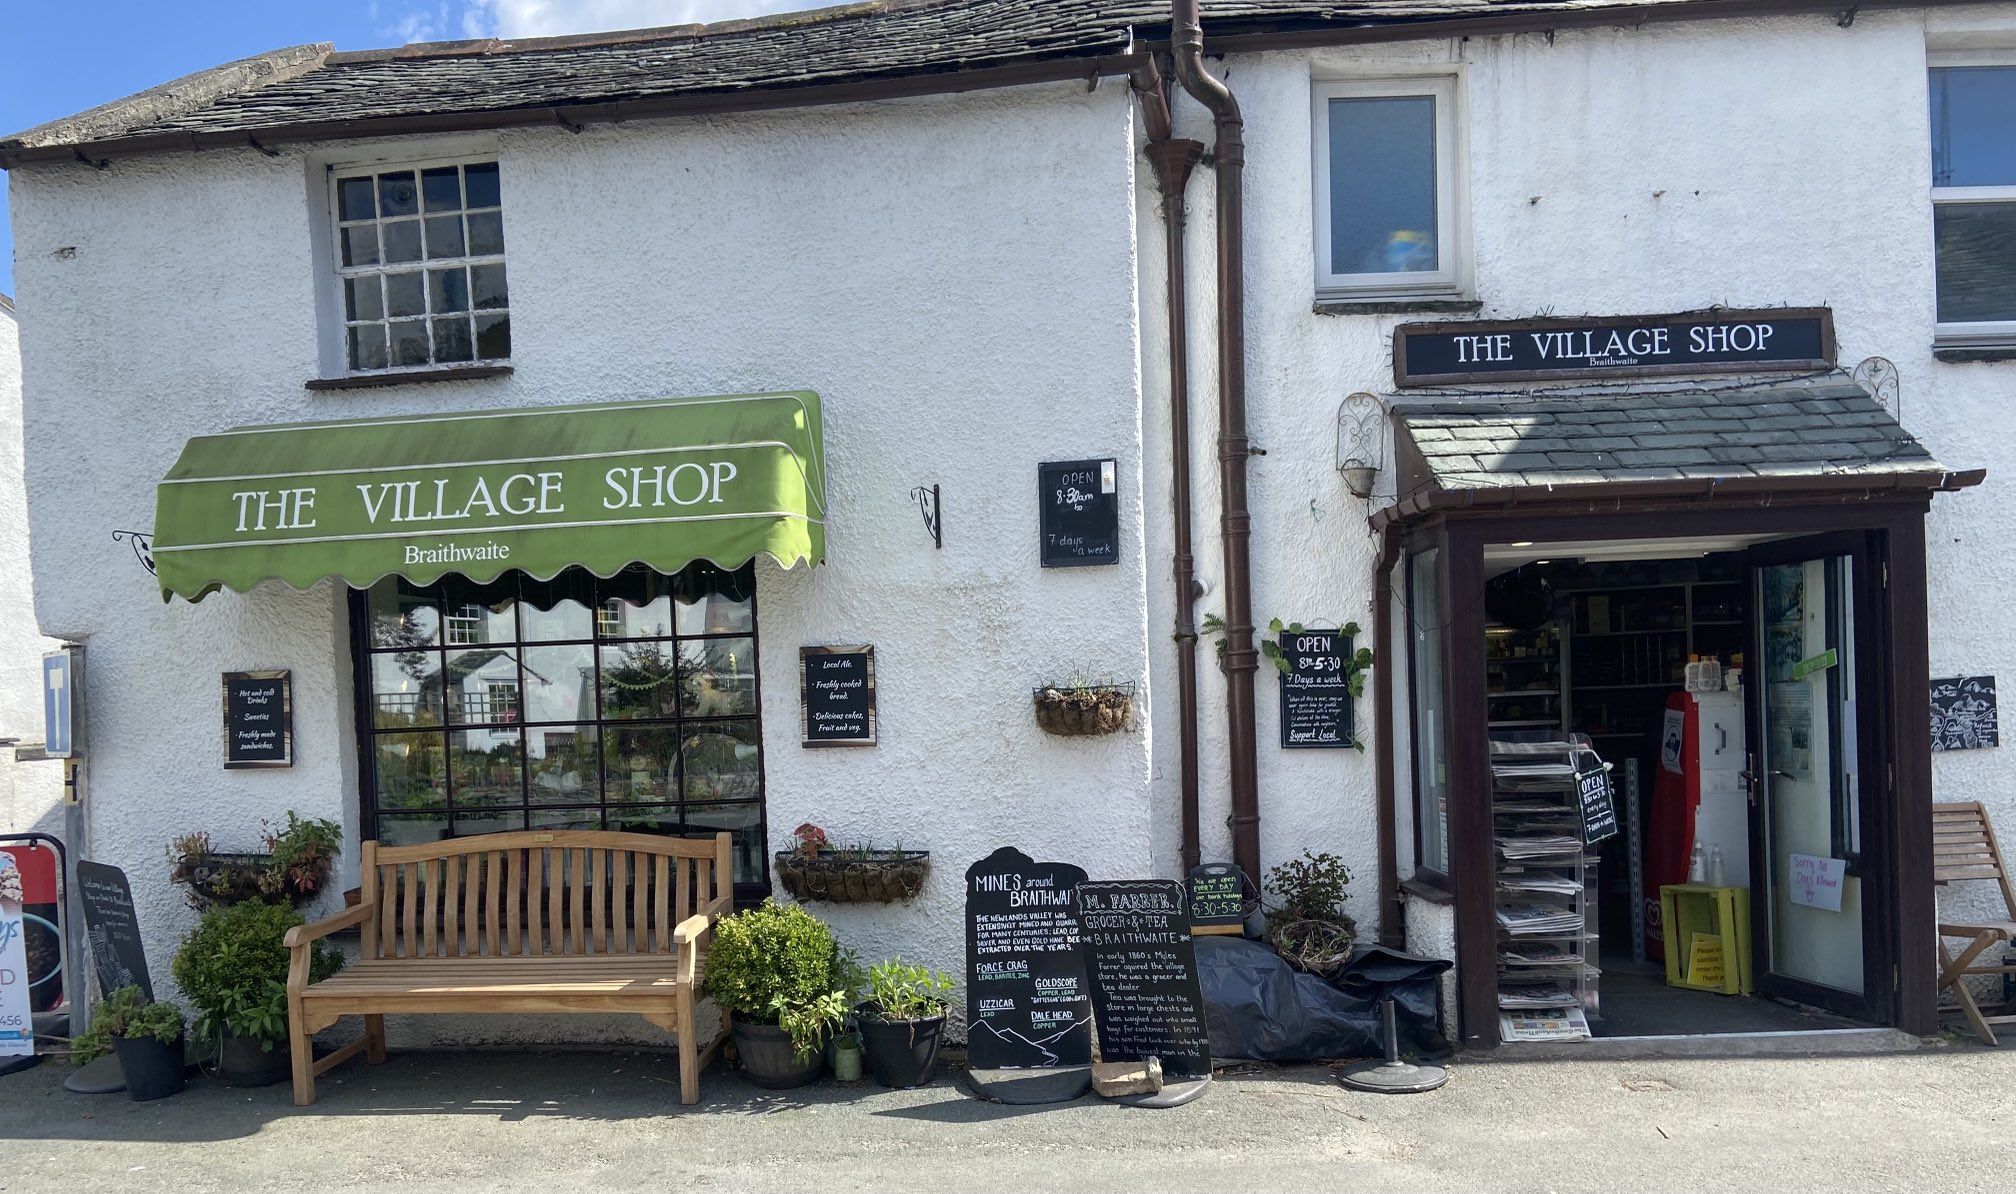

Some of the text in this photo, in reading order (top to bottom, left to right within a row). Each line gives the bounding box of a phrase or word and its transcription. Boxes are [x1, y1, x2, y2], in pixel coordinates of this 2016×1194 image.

[1454, 324, 1773, 363] THE VILLAGE SHOP
[1589, 356, 1638, 367] Braithwaite
[1062, 470, 1094, 485] OPEN
[232, 461, 737, 533] THE VILLAGE SHOP
[1048, 534, 1083, 553] 7 days
[1077, 543, 1111, 556] a week
[404, 540, 510, 565] Braithwaite
[1296, 636, 1331, 652] OPEN
[822, 659, 852, 669] Local Ale.
[816, 679, 862, 691] Freshly cooked
[1287, 673, 1293, 683] 7
[1294, 673, 1314, 690] Days
[1324, 672, 1342, 683] week
[250, 689, 262, 697] and
[263, 688, 275, 696] cold
[829, 691, 848, 700] bread.
[247, 696, 268, 705] Drinks
[244, 712, 270, 721] Sweeties
[815, 711, 864, 720] Delicious cakes,
[818, 723, 861, 733] Fruit and veg.
[238, 729, 276, 740] Freshly made
[1289, 728, 1336, 743] Support Local
[240, 741, 274, 750] sandwiches.
[1581, 774, 1604, 793] OPEN
[1793, 856, 1828, 875] Sorry No
[975, 873, 1054, 892] MINES around
[1220, 876, 1236, 884] open
[1193, 882, 1234, 892] EVERY DAY
[1010, 889, 1074, 907] BRAITHWAI
[1085, 893, 1175, 909] M. FARRER.
[976, 911, 1067, 923] THE NEWLANDS VALLEY WAS
[1085, 915, 1168, 931] GROCER & TEA
[976, 922, 1016, 931] EXTENSIVELY
[1055, 918, 1077, 926] QUARR
[977, 930, 990, 939] FOR
[1069, 927, 1080, 935] COP
[1094, 932, 1178, 945] BRAITHWAITE
[976, 938, 996, 947] SILVER
[1012, 937, 1030, 945] EVEN
[1031, 936, 1048, 944] GOLD
[1066, 935, 1080, 943] BEE
[977, 945, 1012, 954] EXTRACTED
[1013, 944, 1030, 952] OVER
[1047, 943, 1074, 952] YEARS.
[1107, 951, 1125, 963] early
[1154, 951, 1177, 964] Myles
[976, 959, 1028, 974] FORCE CRAG
[1098, 961, 1120, 970] Farrer
[1151, 961, 1164, 970] the
[1165, 961, 1185, 973] village
[1035, 977, 1078, 988] GOLDSCOPE
[1098, 972, 1118, 980] store,
[1118, 972, 1127, 980] he
[1152, 974, 1174, 984] grocer
[1175, 972, 1187, 980] and
[1101, 982, 1141, 991] tea dealer.
[1107, 991, 1122, 1001] Tea
[1138, 994, 1165, 1004] brought
[1167, 994, 1175, 1002] to
[1176, 994, 1188, 1003] the
[980, 999, 1015, 1009] UZZICAR
[1136, 1004, 1154, 1015] large
[1156, 1004, 1180, 1013] chests
[1182, 1004, 1194, 1013] and
[0, 1014, 22, 1026] 456
[1031, 1011, 1073, 1020] DALE HEAD
[1124, 1016, 1149, 1025] weighed
[1033, 1022, 1057, 1030] COPPER
[1106, 1025, 1121, 1034] bags
[1123, 1025, 1134, 1034] for
[1135, 1025, 1171, 1034] customers.
[1148, 1036, 1162, 1044] took
[1192, 1039, 1199, 1048] by
[1187, 1049, 1200, 1057] the
